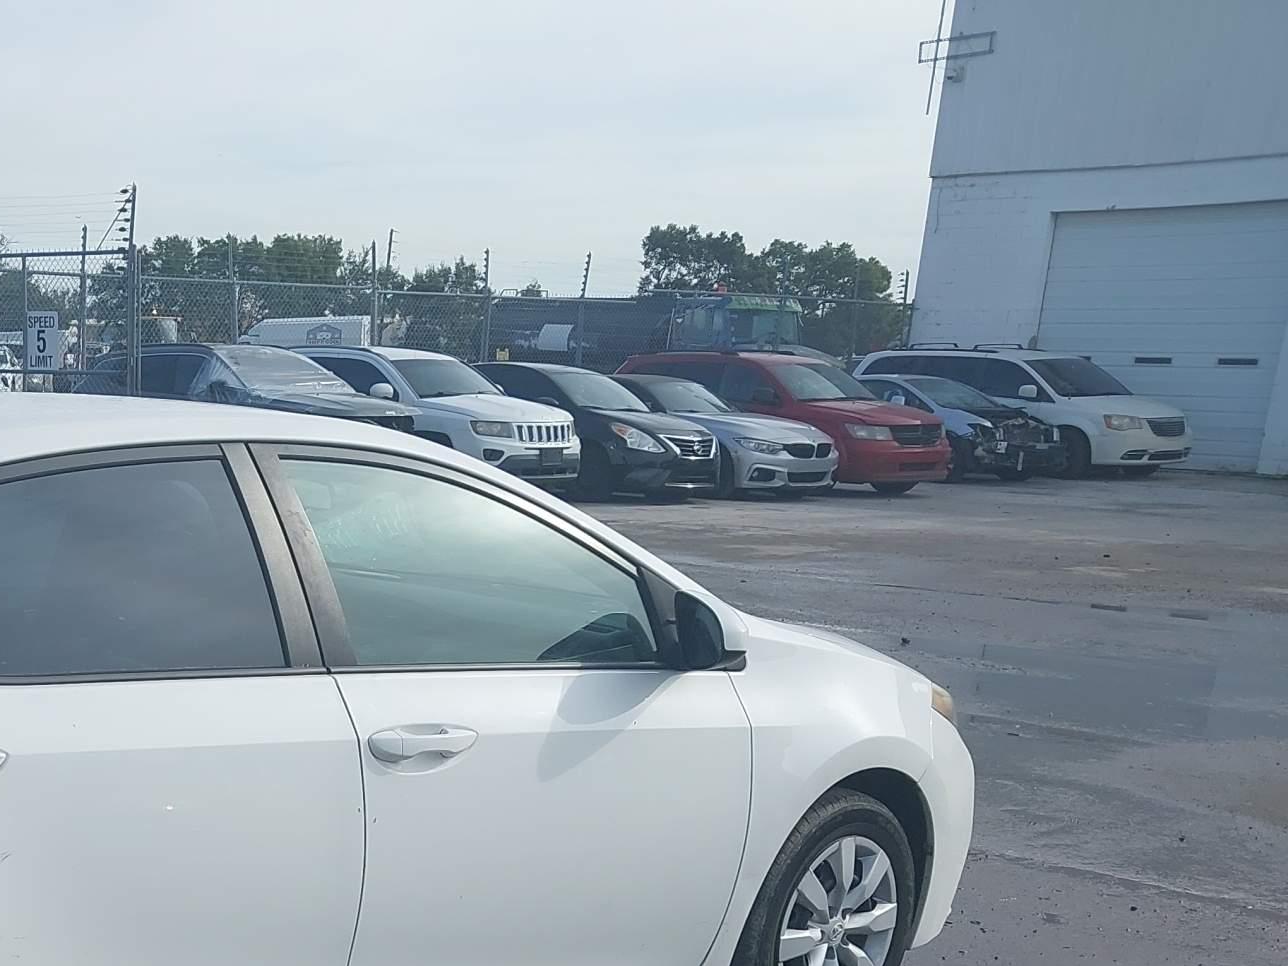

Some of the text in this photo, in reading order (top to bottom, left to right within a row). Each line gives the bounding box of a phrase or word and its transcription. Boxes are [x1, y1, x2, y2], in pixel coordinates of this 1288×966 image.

[28, 316, 55, 328] SPEED
[36, 329, 47, 353] 5
[29, 355, 54, 368] LIMIT
